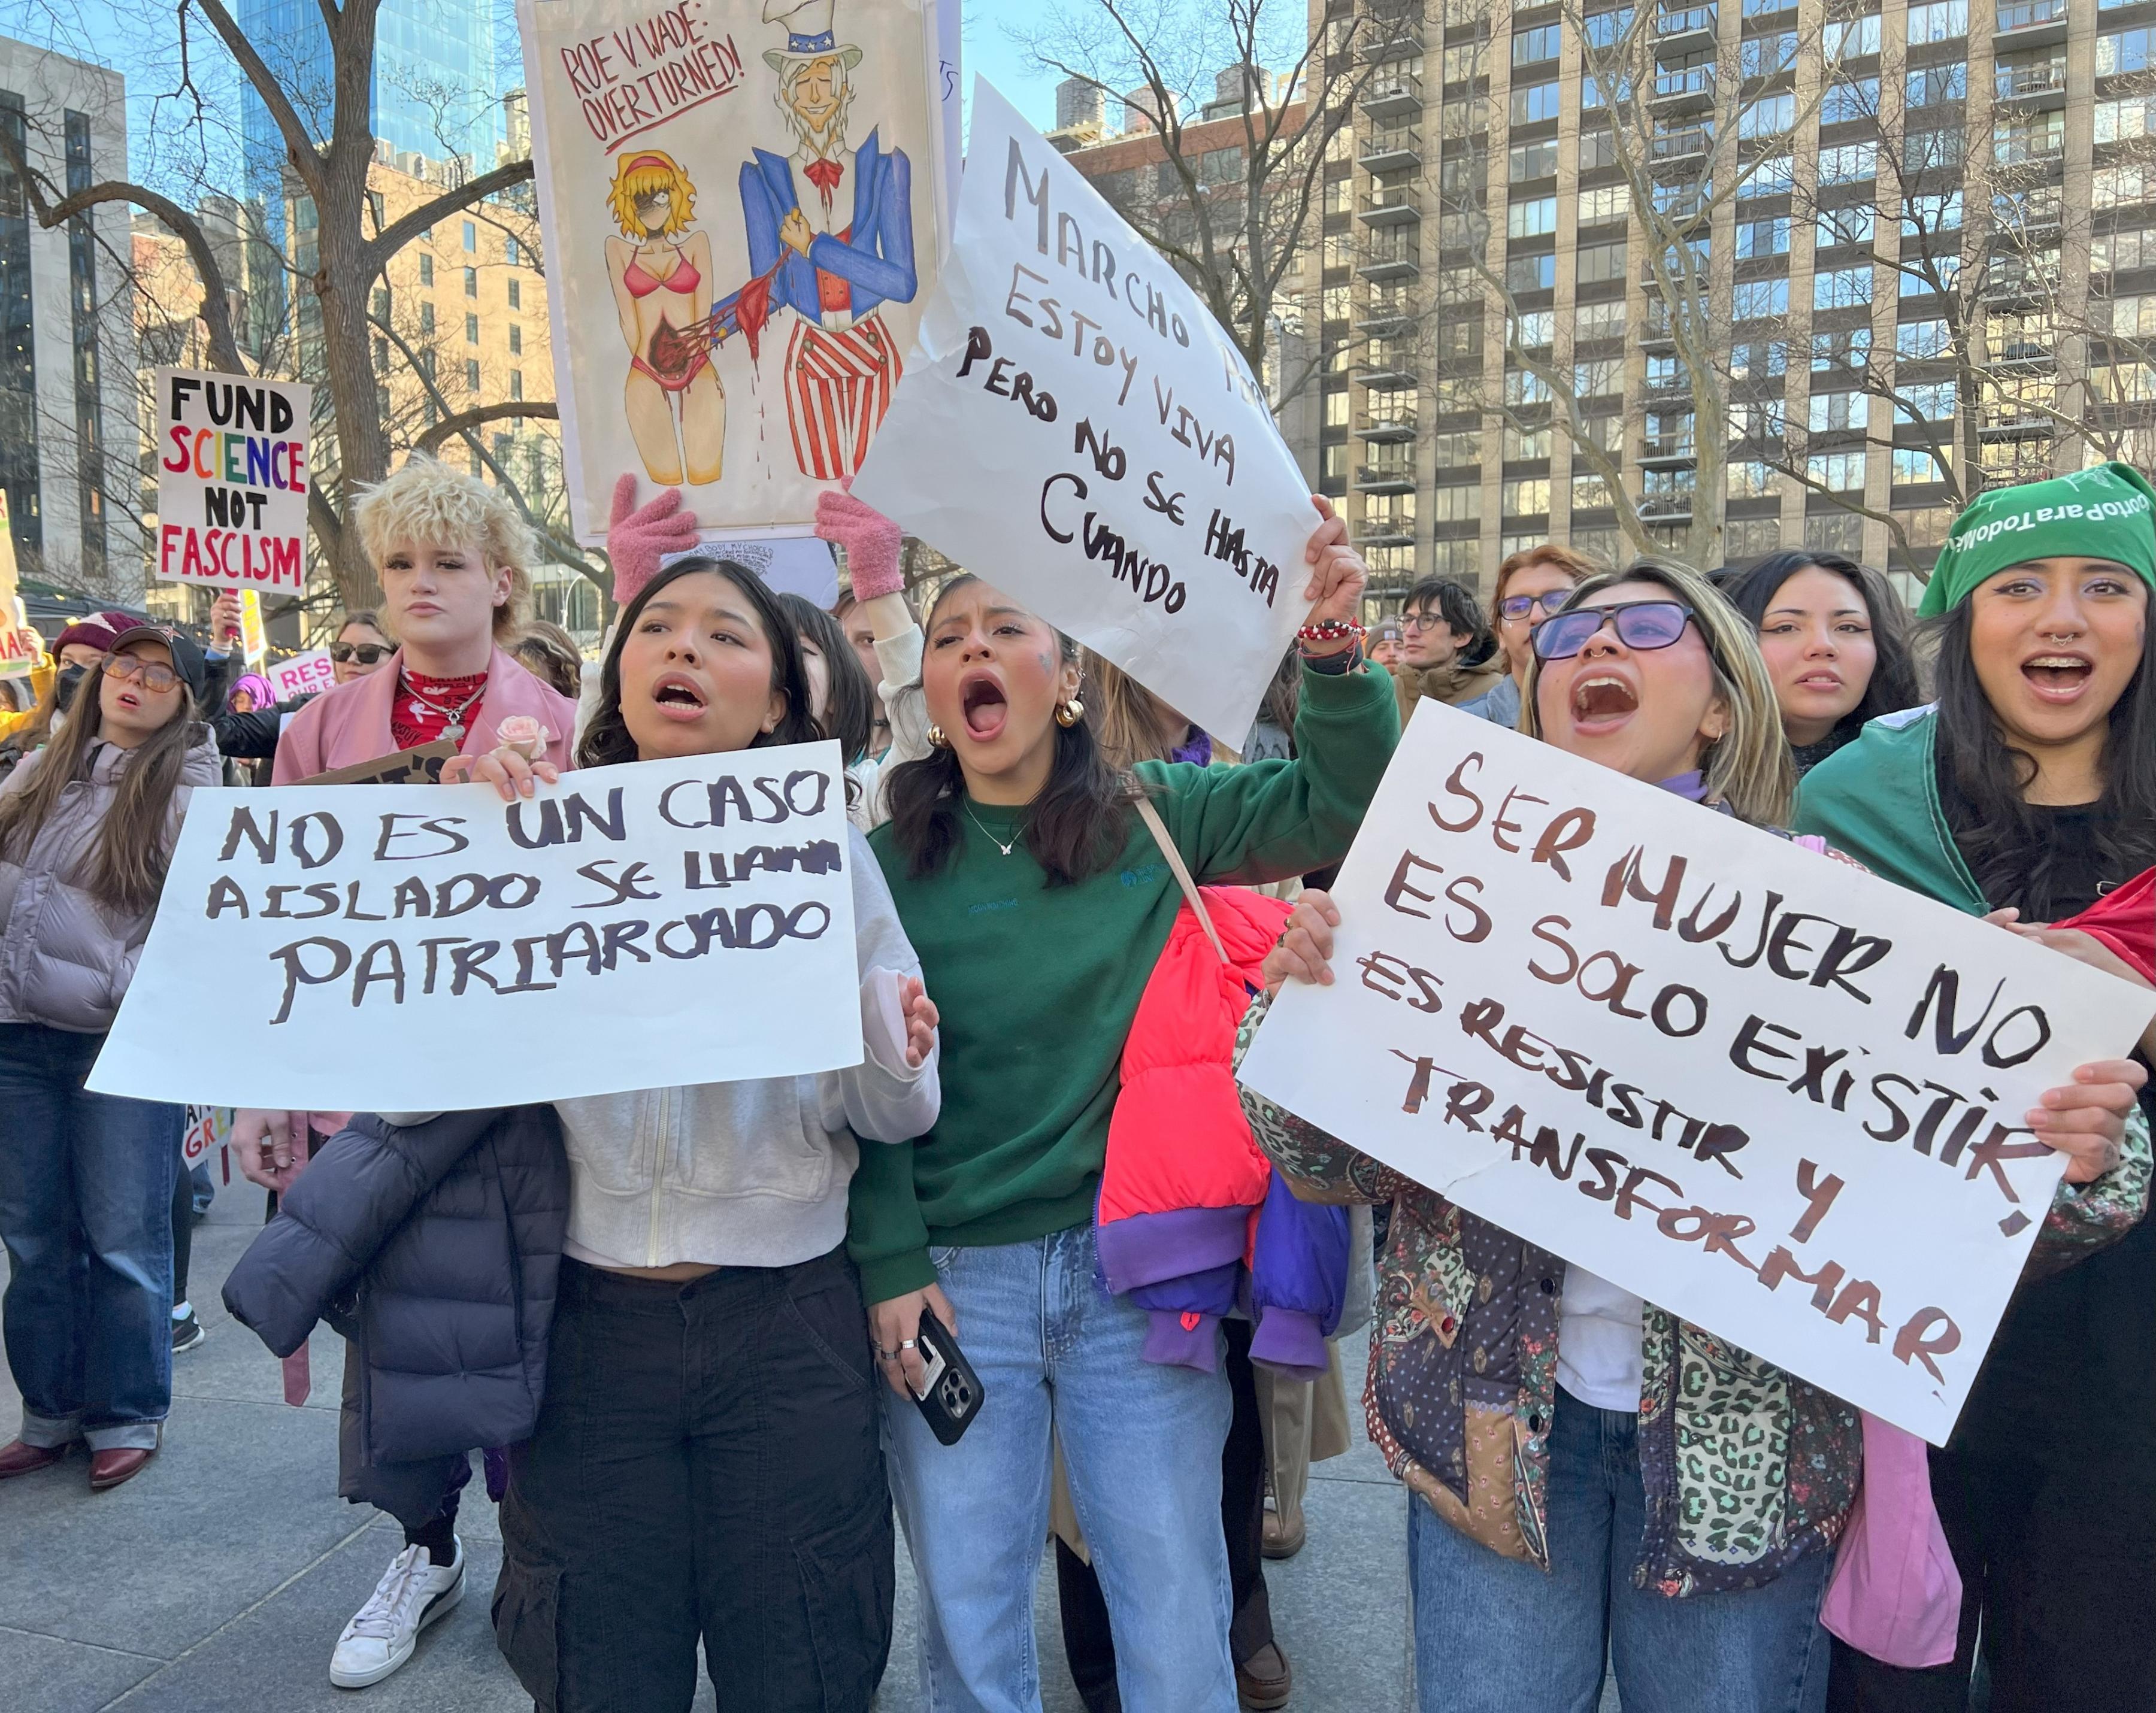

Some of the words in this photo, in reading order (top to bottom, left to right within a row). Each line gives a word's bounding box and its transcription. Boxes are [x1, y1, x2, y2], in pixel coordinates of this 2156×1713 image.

[561, 37, 619, 99] ROE
[613, 26, 641, 69] V.
[635, 1, 708, 59] WADE:
[582, 34, 744, 141] OVERTURNED!
[1005, 135, 1189, 348] MARCHO
[171, 377, 293, 433] FUND
[1006, 262, 1137, 406] ESTOY
[1153, 374, 1236, 489] VIVA
[163, 425, 305, 493] SCIENCE
[205, 487, 268, 530] NOT
[956, 326, 1058, 423] PERO
[1074, 417, 1127, 481] NO
[1143, 471, 1186, 526] SE
[1204, 509, 1279, 610] HASTA
[162, 524, 301, 587] FASCISM
[1041, 473, 1186, 614] CUANDO
[217, 807, 343, 869] NO
[374, 814, 469, 860] ES
[506, 787, 626, 849] UN
[658, 771, 830, 828] CASO
[206, 874, 541, 920] AISLADO
[571, 860, 662, 908] SE
[1385, 849, 1492, 944] ES
[1528, 915, 1708, 1038] SOLO
[1428, 752, 1595, 882] SER
[1601, 845, 1892, 1005] MUJER
[1904, 963, 2051, 1069] NO
[270, 902, 831, 1024] PATRIARCADO
[1356, 951, 1444, 1014] ES
[1460, 998, 1750, 1181] RESISTIR
[1789, 1158, 1845, 1244] Y
[1388, 1049, 1961, 1385] TRANSFORMAR
